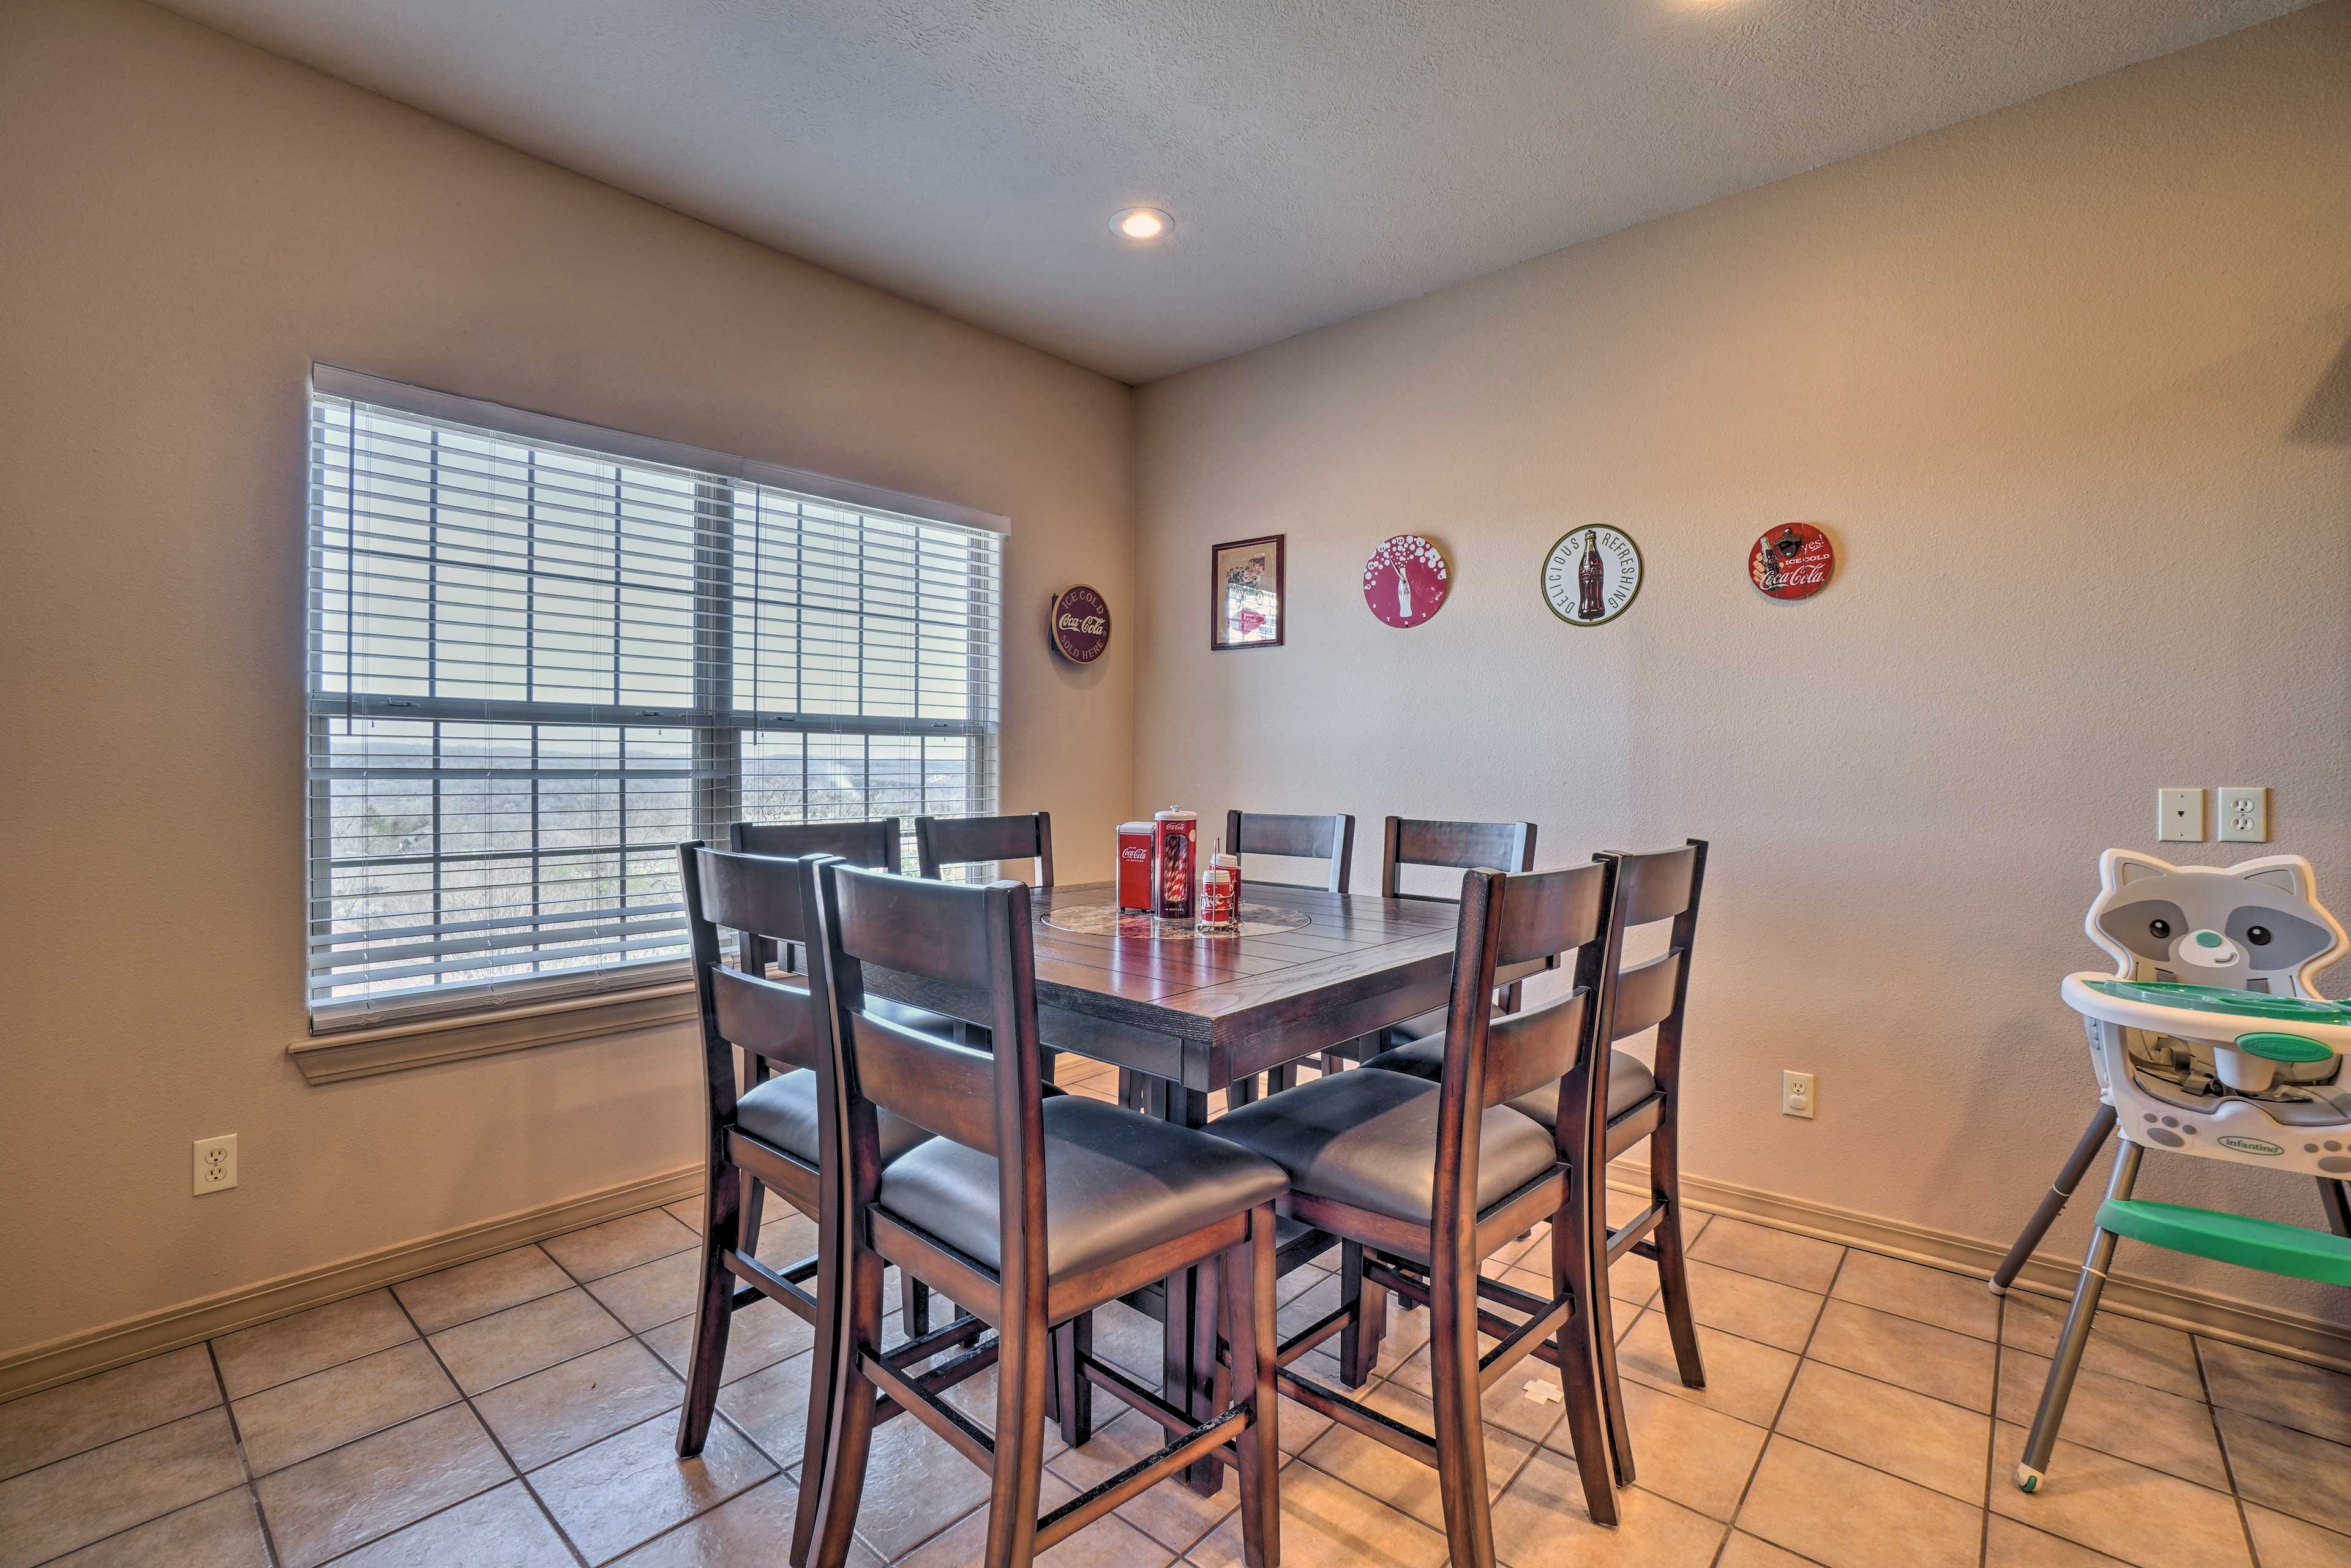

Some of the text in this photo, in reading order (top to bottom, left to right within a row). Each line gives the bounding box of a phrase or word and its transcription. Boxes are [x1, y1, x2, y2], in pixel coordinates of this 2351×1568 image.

[1802, 553, 1829, 562] COLD
[1549, 538, 1580, 614] DELICIOUS
[1602, 533, 1635, 609] REFRESHING
[1759, 563, 1825, 590] Coca-Cola
[1062, 590, 1104, 614] ICE COLD
[1059, 613, 1106, 635] Coca-Cola
[1061, 635, 1104, 659] SOLD HERE
[1122, 848, 1148, 859] Coca-Cola
[2225, 1138, 2278, 1153] infantino
